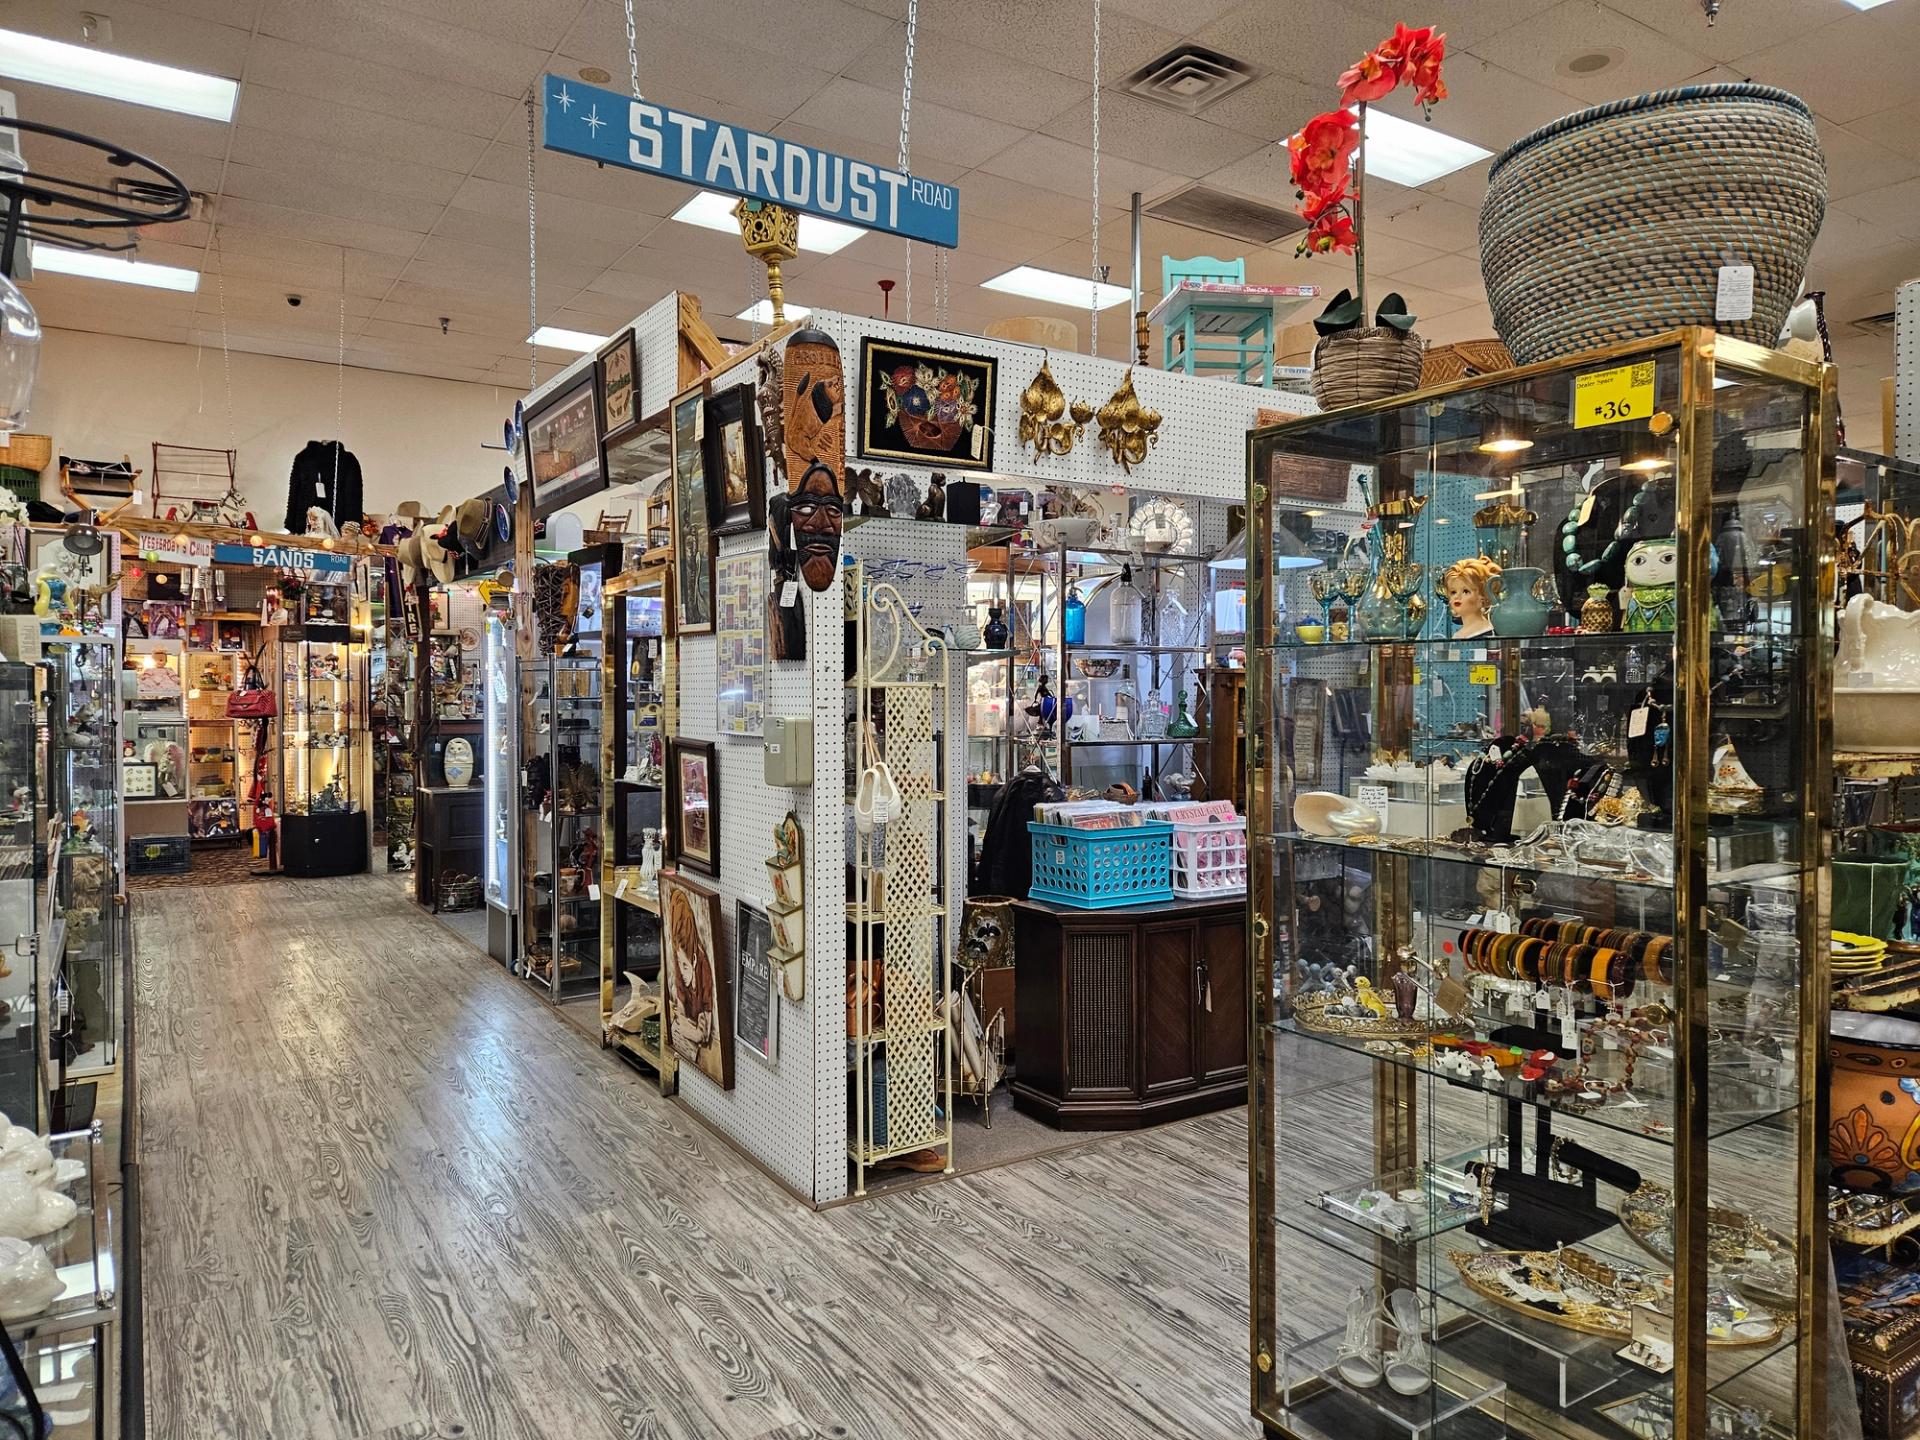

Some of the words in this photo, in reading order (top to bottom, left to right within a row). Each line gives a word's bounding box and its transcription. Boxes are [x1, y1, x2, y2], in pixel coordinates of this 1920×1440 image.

[629, 101, 909, 229] STARDUST
[912, 178, 953, 211] ROAD
[1594, 397, 1631, 420] #36
[141, 535, 187, 554] YESTERDAYS
[253, 548, 314, 569] SANDS
[330, 555, 348, 565] ROAD
[1176, 808, 1206, 820] CRYSTAL
[1207, 804, 1229, 815] GAYLE
